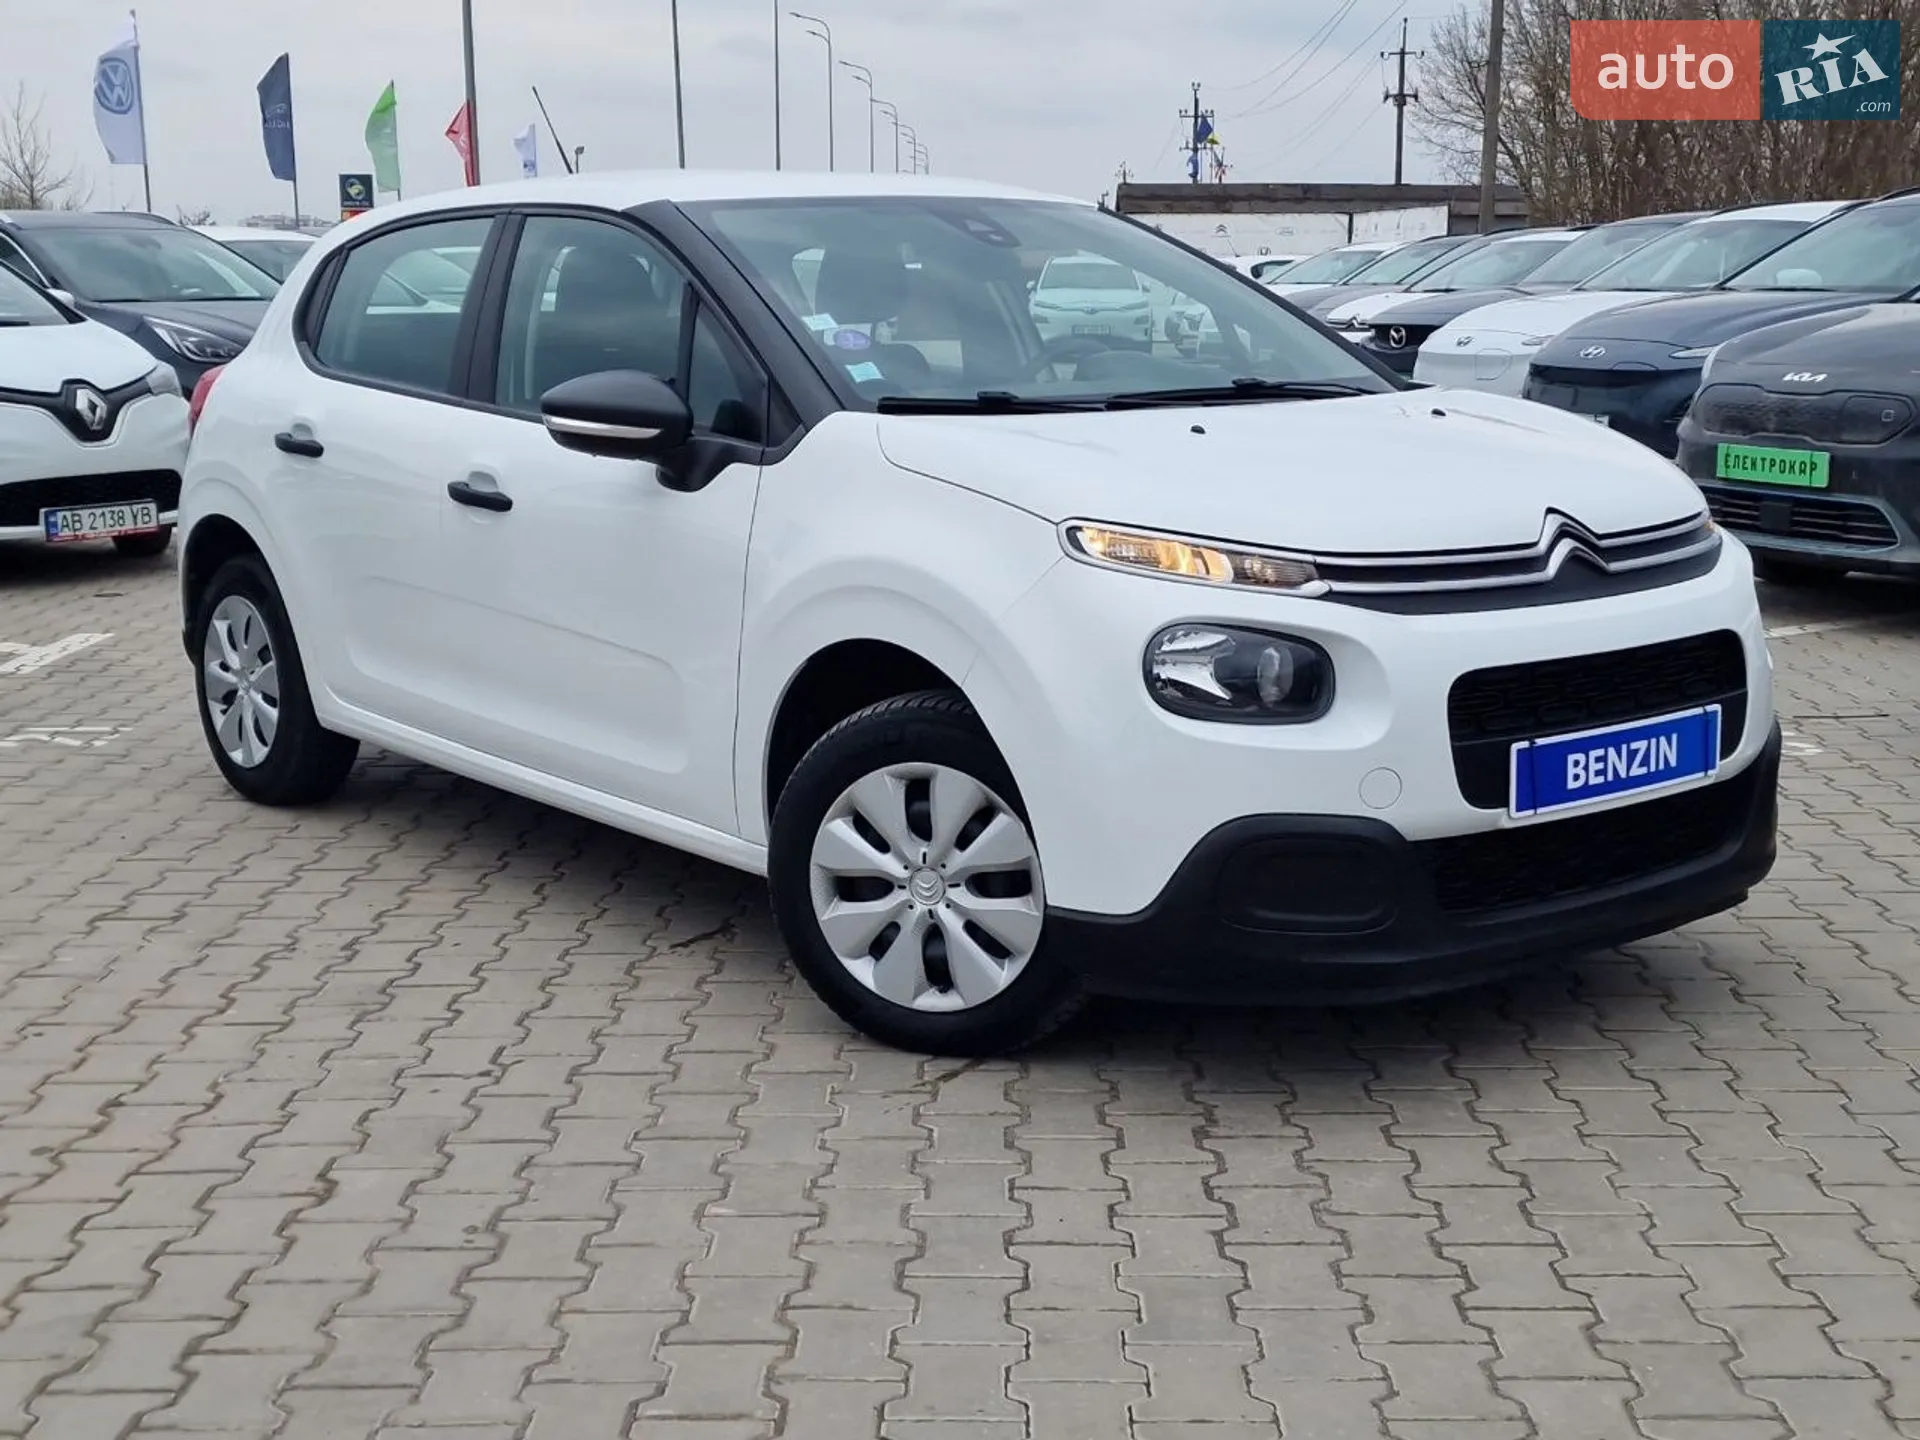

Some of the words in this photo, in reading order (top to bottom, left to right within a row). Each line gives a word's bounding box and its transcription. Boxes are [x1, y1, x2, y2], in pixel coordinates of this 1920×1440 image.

[1725, 453, 1818, 477] ЕЛЕКТРОКАР
[60, 512, 83, 533] AB
[87, 509, 126, 531] 2138
[1566, 733, 1679, 790] BENZIN
